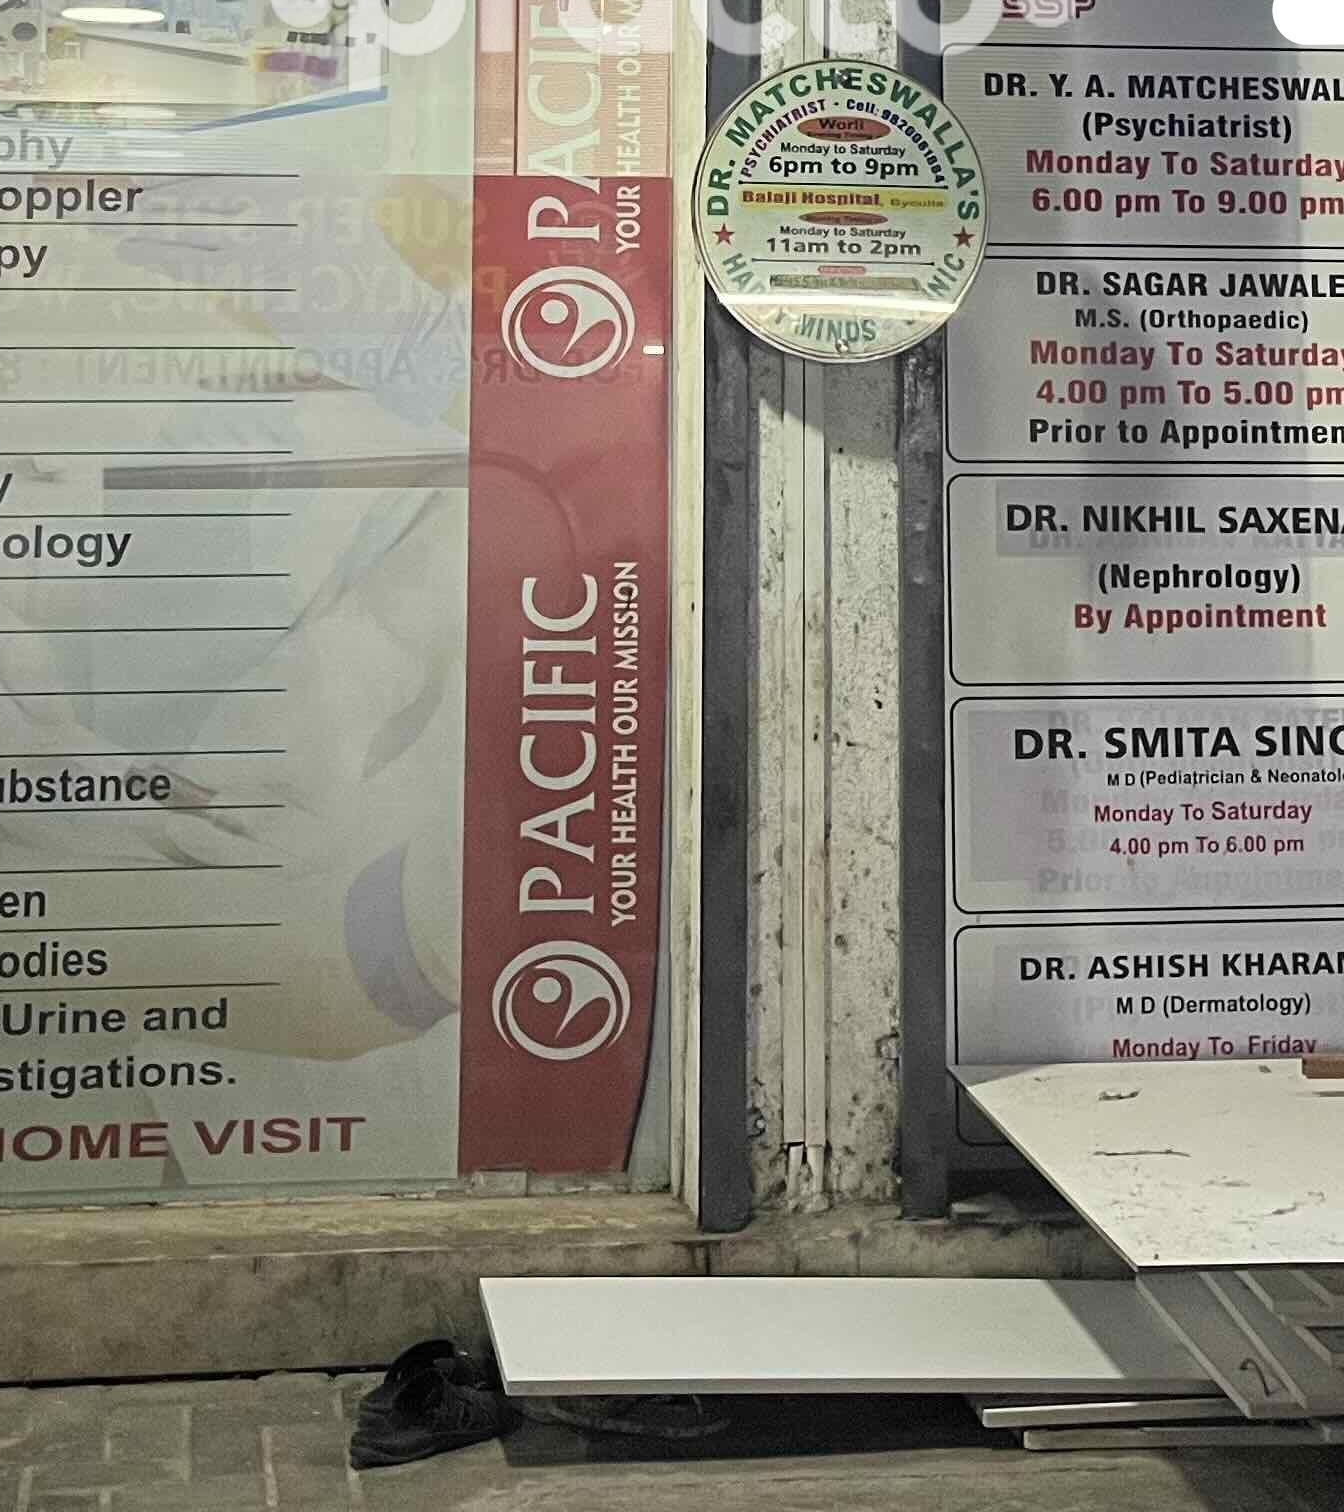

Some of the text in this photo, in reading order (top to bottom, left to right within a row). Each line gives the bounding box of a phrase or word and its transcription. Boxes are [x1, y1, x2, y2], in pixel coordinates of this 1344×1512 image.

[618, 25, 641, 77] OUR
[984, 73, 1037, 97] DR.
[1049, 74, 1072, 97] Y.
[1085, 75, 1115, 98] A.
[618, 85, 640, 176] HEALTH
[741, 99, 827, 177] PSYCHIATRIST
[1082, 112, 1292, 143] (Psychiatrist)
[780, 142, 906, 157] Monday to Saturday
[769, 156, 919, 179] 6pm to 9pm
[707, 159, 735, 216] DR.
[616, 185, 640, 254] YOUR
[780, 225, 906, 239] Monday to Saturday
[766, 239, 921, 258] 11am to 2pm
[1036, 272, 1344, 298] DR. SAGAR JAWALE
[1006, 504, 1068, 532] DR.
[1083, 506, 1204, 533] NIKHIL
[1098, 564, 1300, 594] (Nephrology)
[519, 574, 598, 914] PACIFIC
[612, 562, 638, 926] YOUR HEALTH OUR MISSION
[1015, 728, 1087, 759] DR.
[1105, 727, 1239, 758] SMITA
[1020, 957, 1075, 980] DR.
[1088, 954, 1209, 979] ASHISH
[1, 1002, 126, 1037] Urine
[137, 997, 228, 1032] and
[194, 1116, 366, 1156] VISIT
